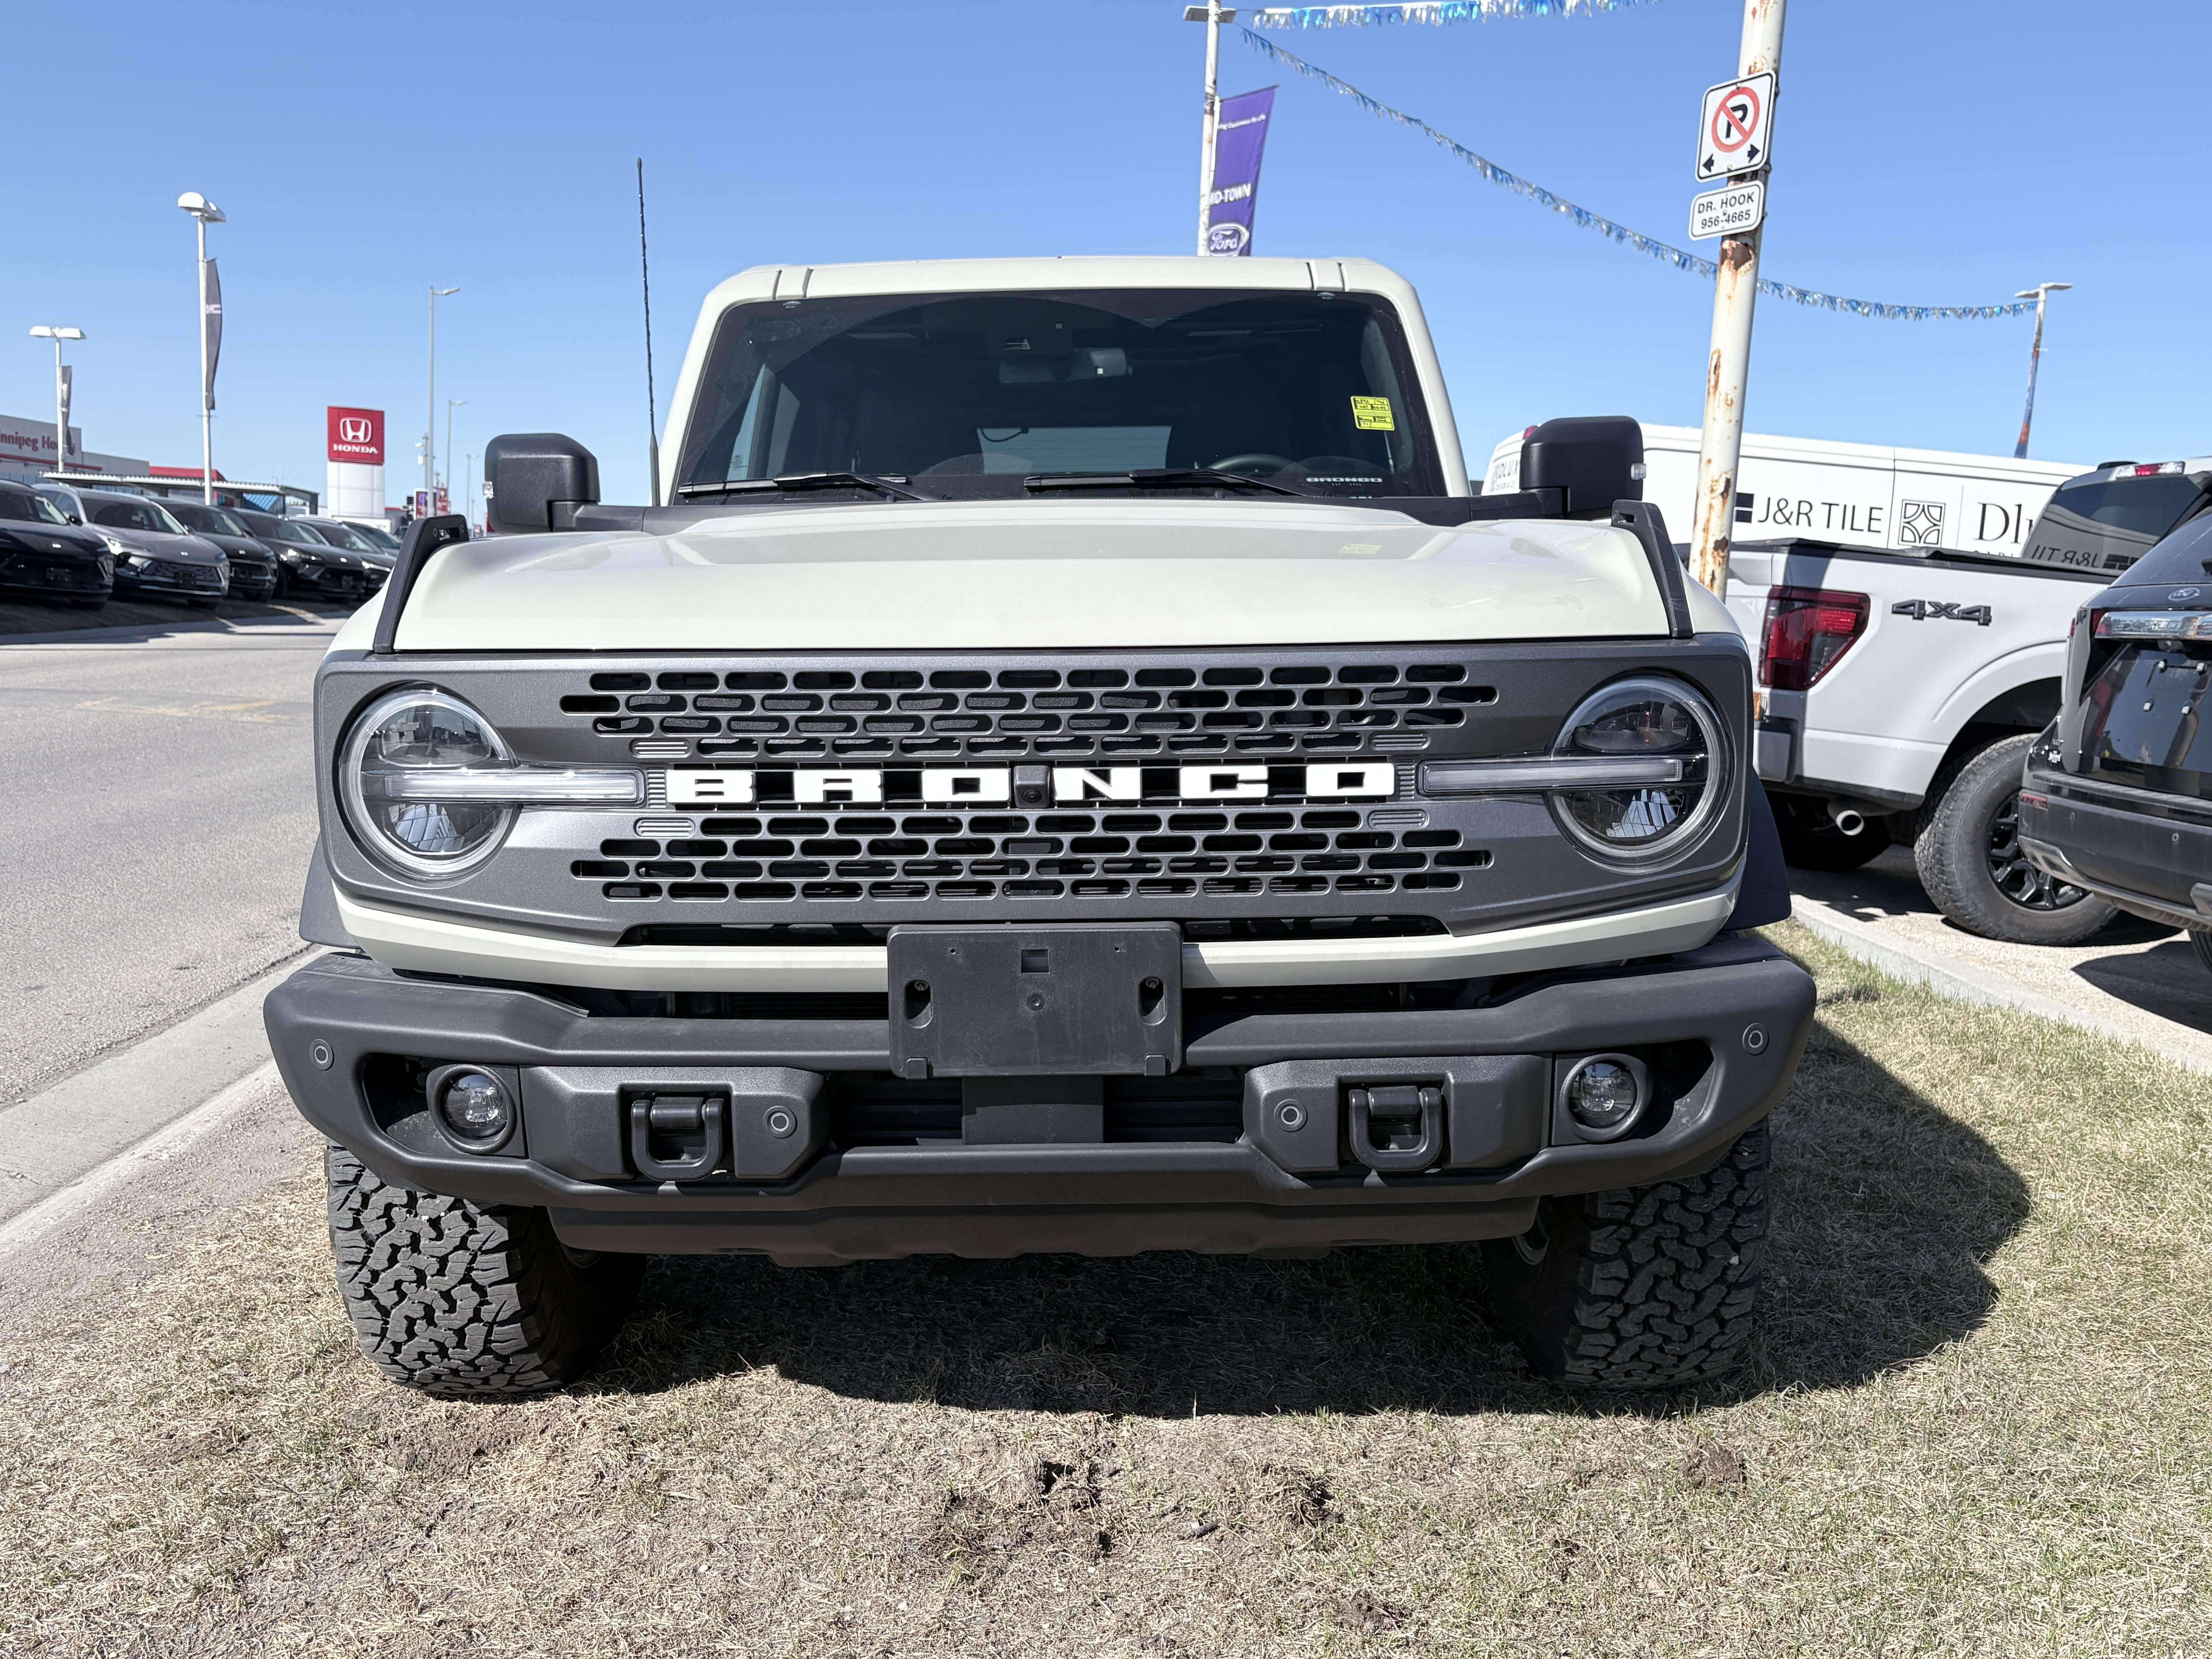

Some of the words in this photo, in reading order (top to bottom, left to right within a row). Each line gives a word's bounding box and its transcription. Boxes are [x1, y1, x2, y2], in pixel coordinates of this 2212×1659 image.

[1698, 201, 1716, 213] DR.
[1721, 192, 1754, 209] HOOK
[1701, 210, 1751, 229] 956-4665
[1210, 230, 1240, 251] Ford
[333, 443, 379, 454] HONDA
[1757, 497, 1813, 527] J&R
[1821, 502, 1883, 533] TILE
[666, 763, 1395, 803] BRONCO
